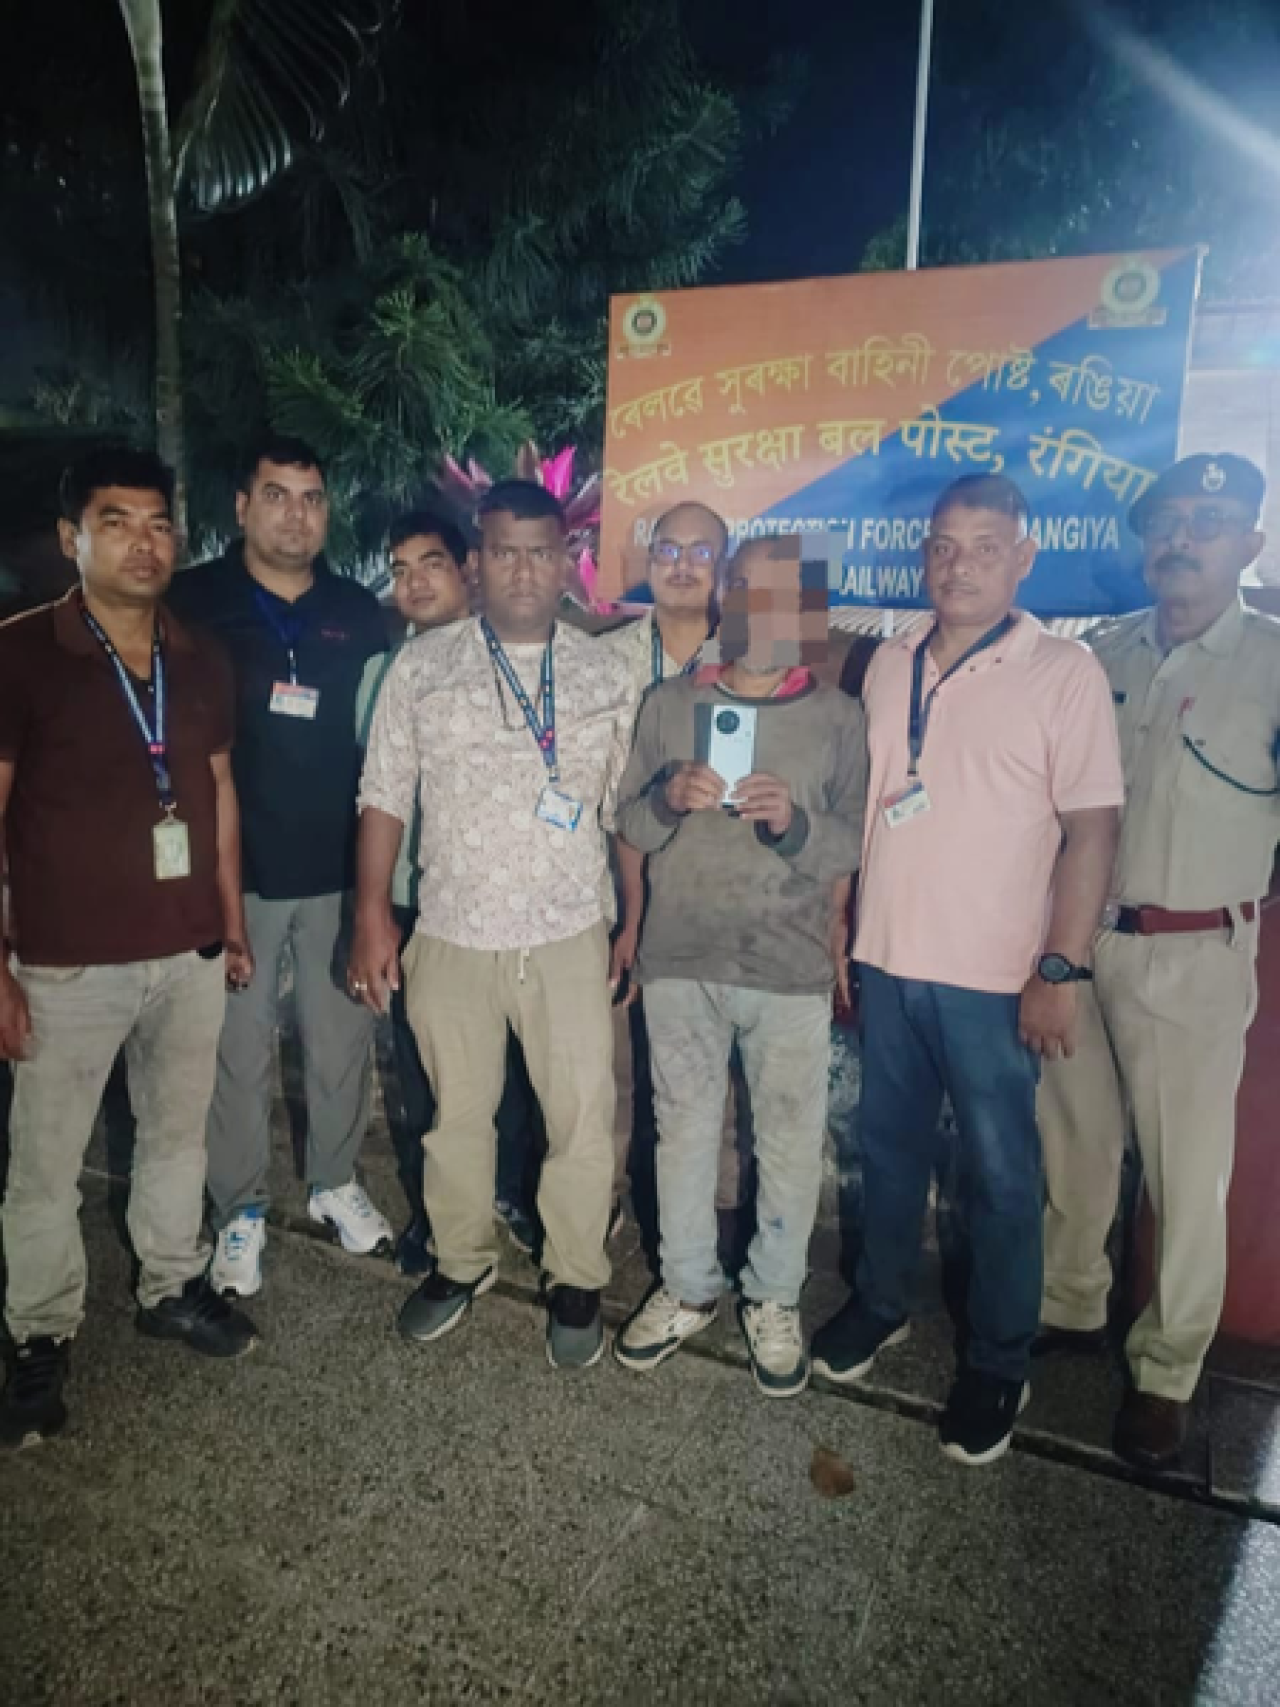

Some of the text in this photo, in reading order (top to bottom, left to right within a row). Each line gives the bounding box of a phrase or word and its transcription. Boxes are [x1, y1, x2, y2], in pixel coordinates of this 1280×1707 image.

[603, 403, 1159, 505] रेलवे सुरक्षा बल पोस्ट, रंगिया
[839, 565, 925, 598] AILWAY
